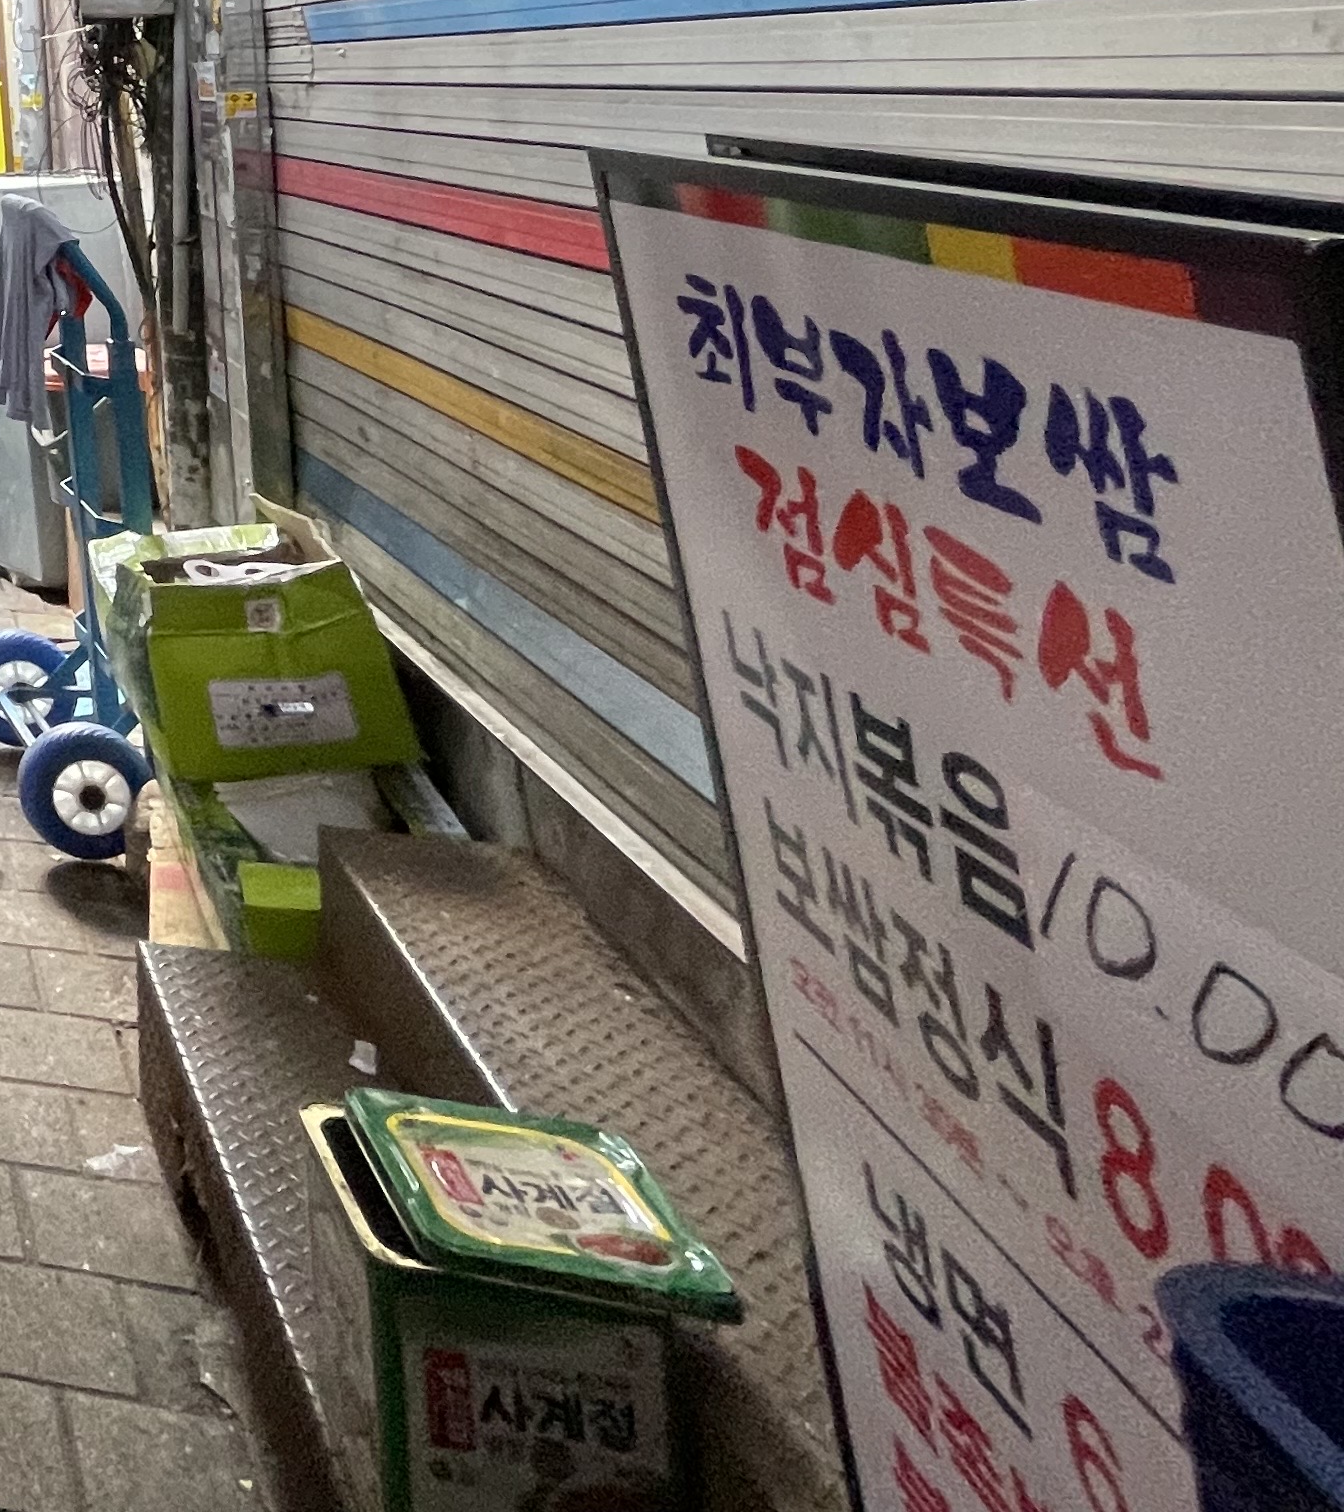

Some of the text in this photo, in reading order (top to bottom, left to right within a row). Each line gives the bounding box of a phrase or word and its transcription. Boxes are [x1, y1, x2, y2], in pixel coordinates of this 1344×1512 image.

[677, 273, 1180, 584] 최부자보쌈
[722, 608, 1036, 953] 낙지볶음
[763, 796, 1077, 1200] 보쌈정식
[862, 1160, 1033, 1441] 냉면
